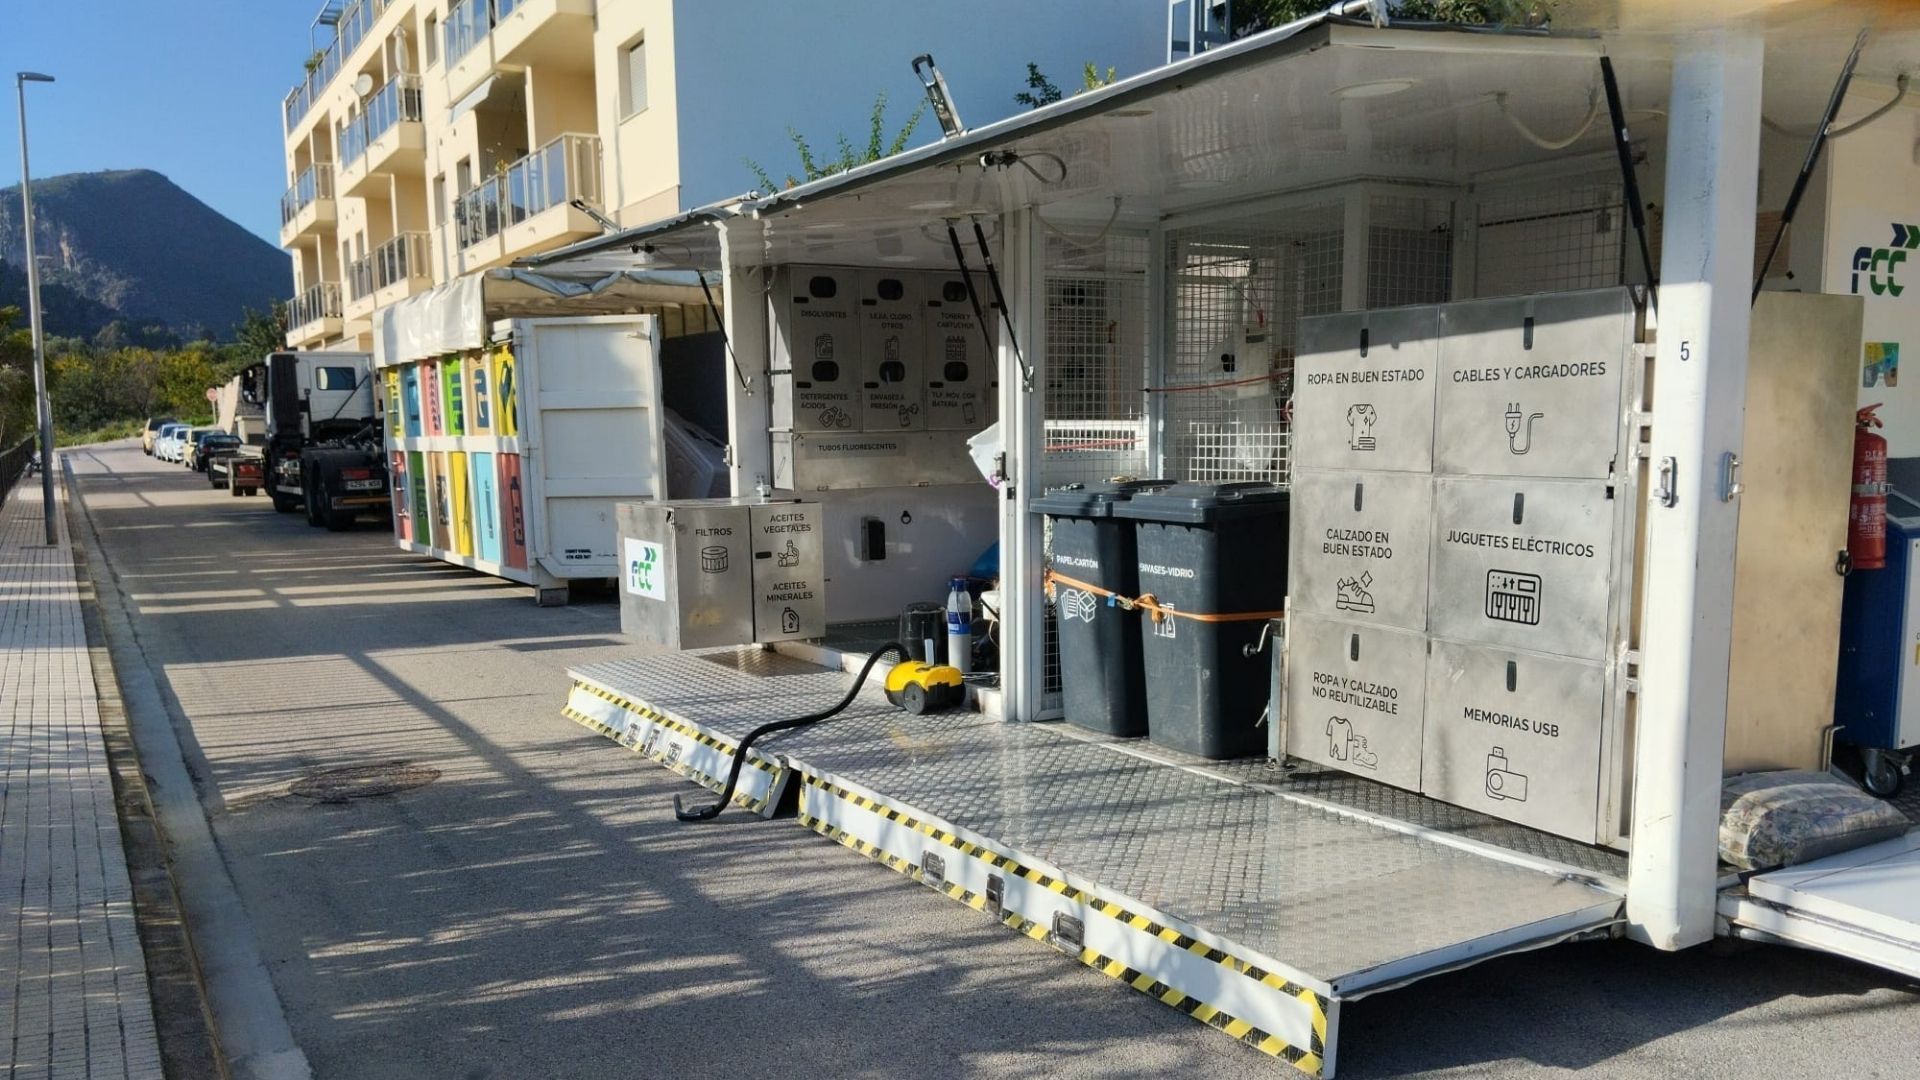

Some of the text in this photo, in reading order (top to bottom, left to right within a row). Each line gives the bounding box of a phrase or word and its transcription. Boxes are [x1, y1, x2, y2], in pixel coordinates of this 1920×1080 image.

[1851, 246, 1907, 297] FCC
[801, 310, 847, 319] DISOLVENTES
[1680, 340, 1690, 362] 5
[1307, 368, 1425, 385] ROPA EN BUEN ESTADO
[1453, 361, 1606, 383] CABLES Y CARGADORES
[800, 392, 848, 401] DETERGENTES
[769, 513, 805, 523] ACEITES
[695, 527, 733, 537] FILTROS
[763, 523, 812, 534] VEGETALES
[1326, 528, 1389, 543] CALZADO EN
[1323, 542, 1392, 559] BUEN ESTADO
[1447, 529, 1594, 558] JUGUETES ELÉCTRICOS
[772, 581, 807, 591] ACEITES
[766, 591, 813, 602] MINERALES
[1313, 671, 1398, 700] ROPA Y CALZADO
[1312, 685, 1398, 715] NO REUTILIZABLE
[1464, 706, 1559, 738] MEMORIAS USB
